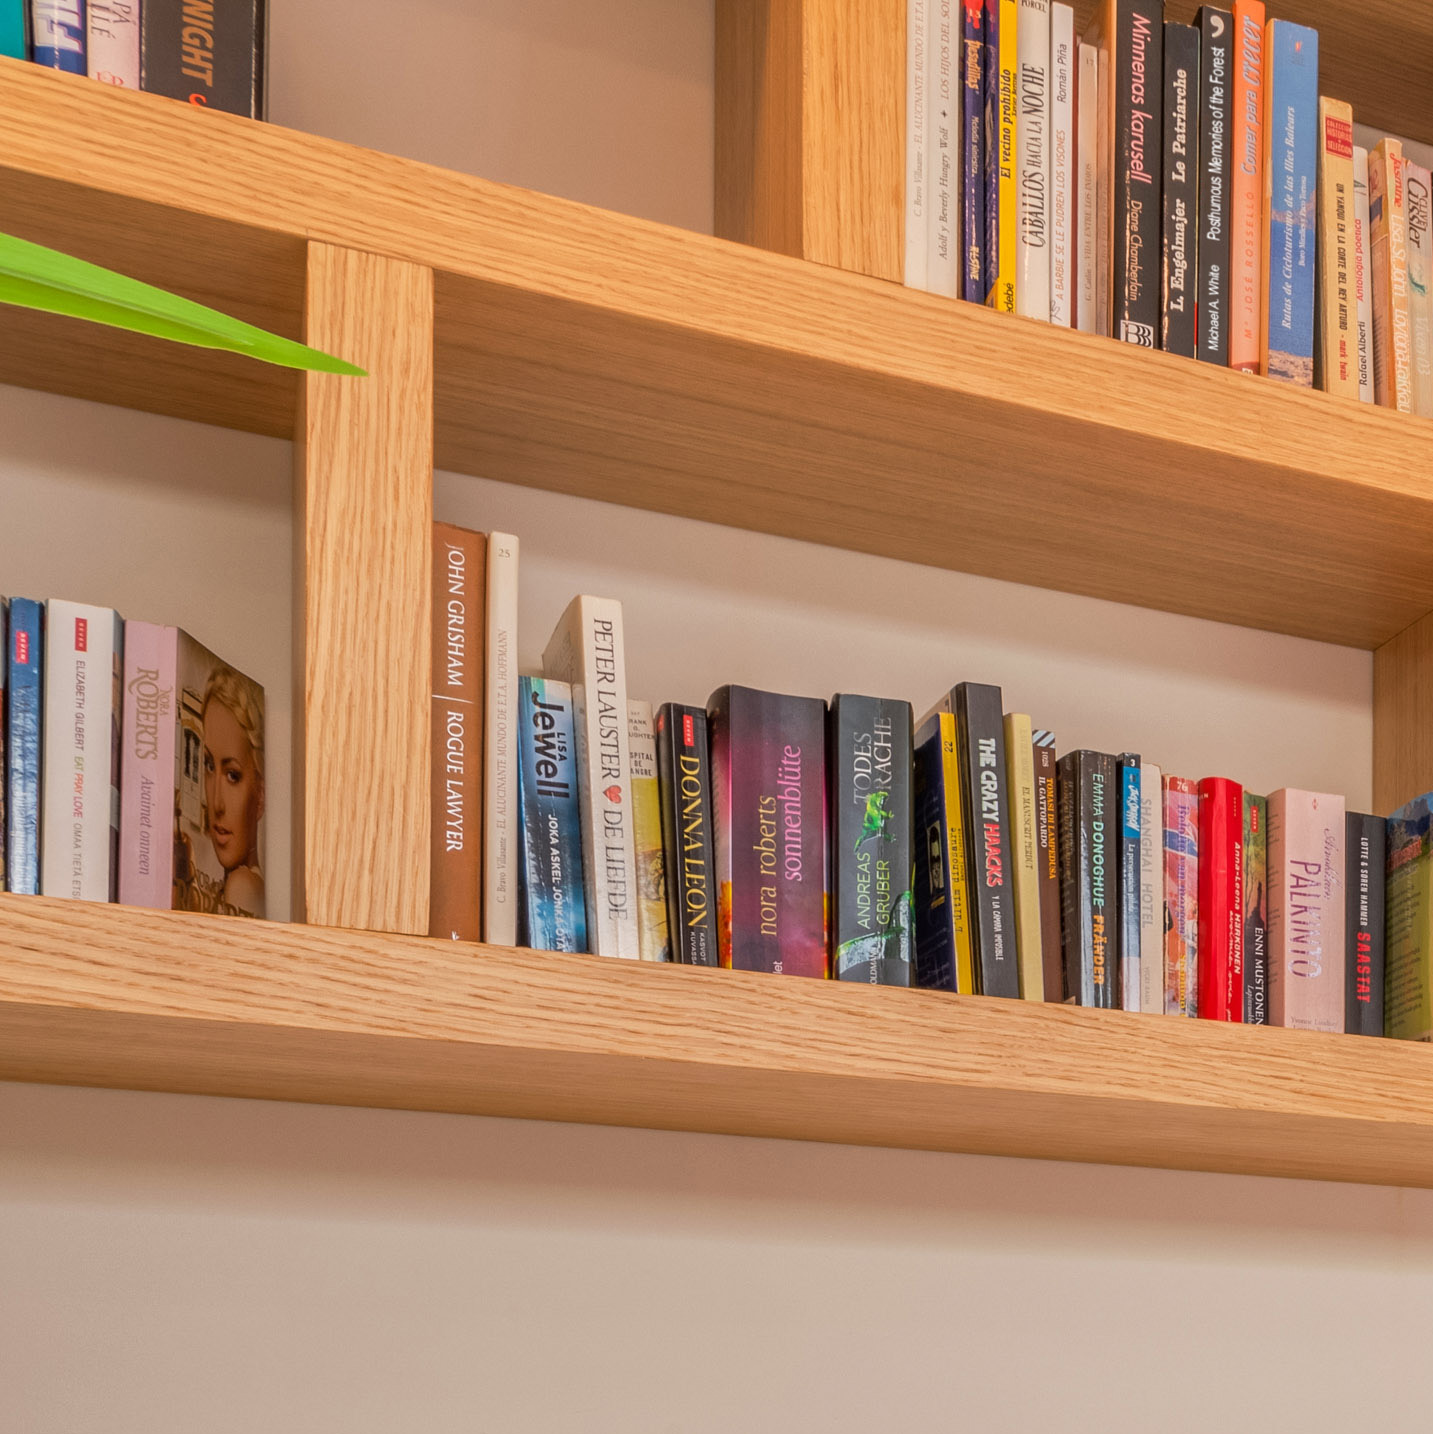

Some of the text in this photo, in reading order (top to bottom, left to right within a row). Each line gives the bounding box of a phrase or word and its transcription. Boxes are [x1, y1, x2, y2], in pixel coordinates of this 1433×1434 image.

[1000, 69, 1012, 164] vecino prohibido
[1130, 11, 1153, 184] Minnenas karusell
[1021, 63, 1046, 249] CABALLOS NOCHE
[1171, 68, 1188, 293] Engelmajer Le Patriarche
[1207, 46, 1225, 351] Michael White Posthumous Memories Forest
[1129, 199, 1143, 302] Diane Chamberlain
[1281, 106, 1296, 331] Rutas Cicloturismo Balears
[1358, 320, 1367, 386] Rafael Alberti
[445, 541, 466, 686] JOHN GRISHAM
[73, 660, 86, 849] ELIZABETH GILBERT EAT PRAY LOVE OMAA
[128, 666, 160, 761] ROBERTS
[498, 630, 508, 817] ALUCINANTE MUNDO HOFFMANN
[531, 692, 570, 799] Jewell
[557, 731, 568, 762] LISA
[593, 618, 628, 920] PETER LAUSTER DE LIEFDE
[853, 731, 873, 806] TODES
[872, 716, 892, 793] RACHE
[944, 740, 954, 753] 22
[140, 776, 156, 829] Avaimet
[446, 710, 464, 852] ROGUE LAWYER
[776, 744, 802, 883] sonnenblüte
[978, 738, 1004, 889] THE CRAZY HAACKS
[1040, 785, 1048, 848] GATTOPARDO
[1046, 778, 1057, 880] TOMASI LAMPEDUSA
[549, 813, 564, 923] JOKA JONKA
[679, 754, 708, 930] DONNA LEON
[752, 795, 777, 938] nora roberts
[856, 852, 871, 930] ANDREAS
[876, 860, 890, 926] GRUBER
[1092, 773, 1105, 908] EMMA DONOGHUE
[1141, 798, 1154, 929] SHANGHAI HOTEL
[1234, 841, 1242, 910] Anna-Leena
[1093, 914, 1105, 986] FRÄNDER
[1287, 859, 1323, 978] PALKINTO
[1356, 837, 1371, 1004] LOTTE HAMMER SAASTAT
[1253, 927, 1265, 1026] ENNI MUSTONEN
